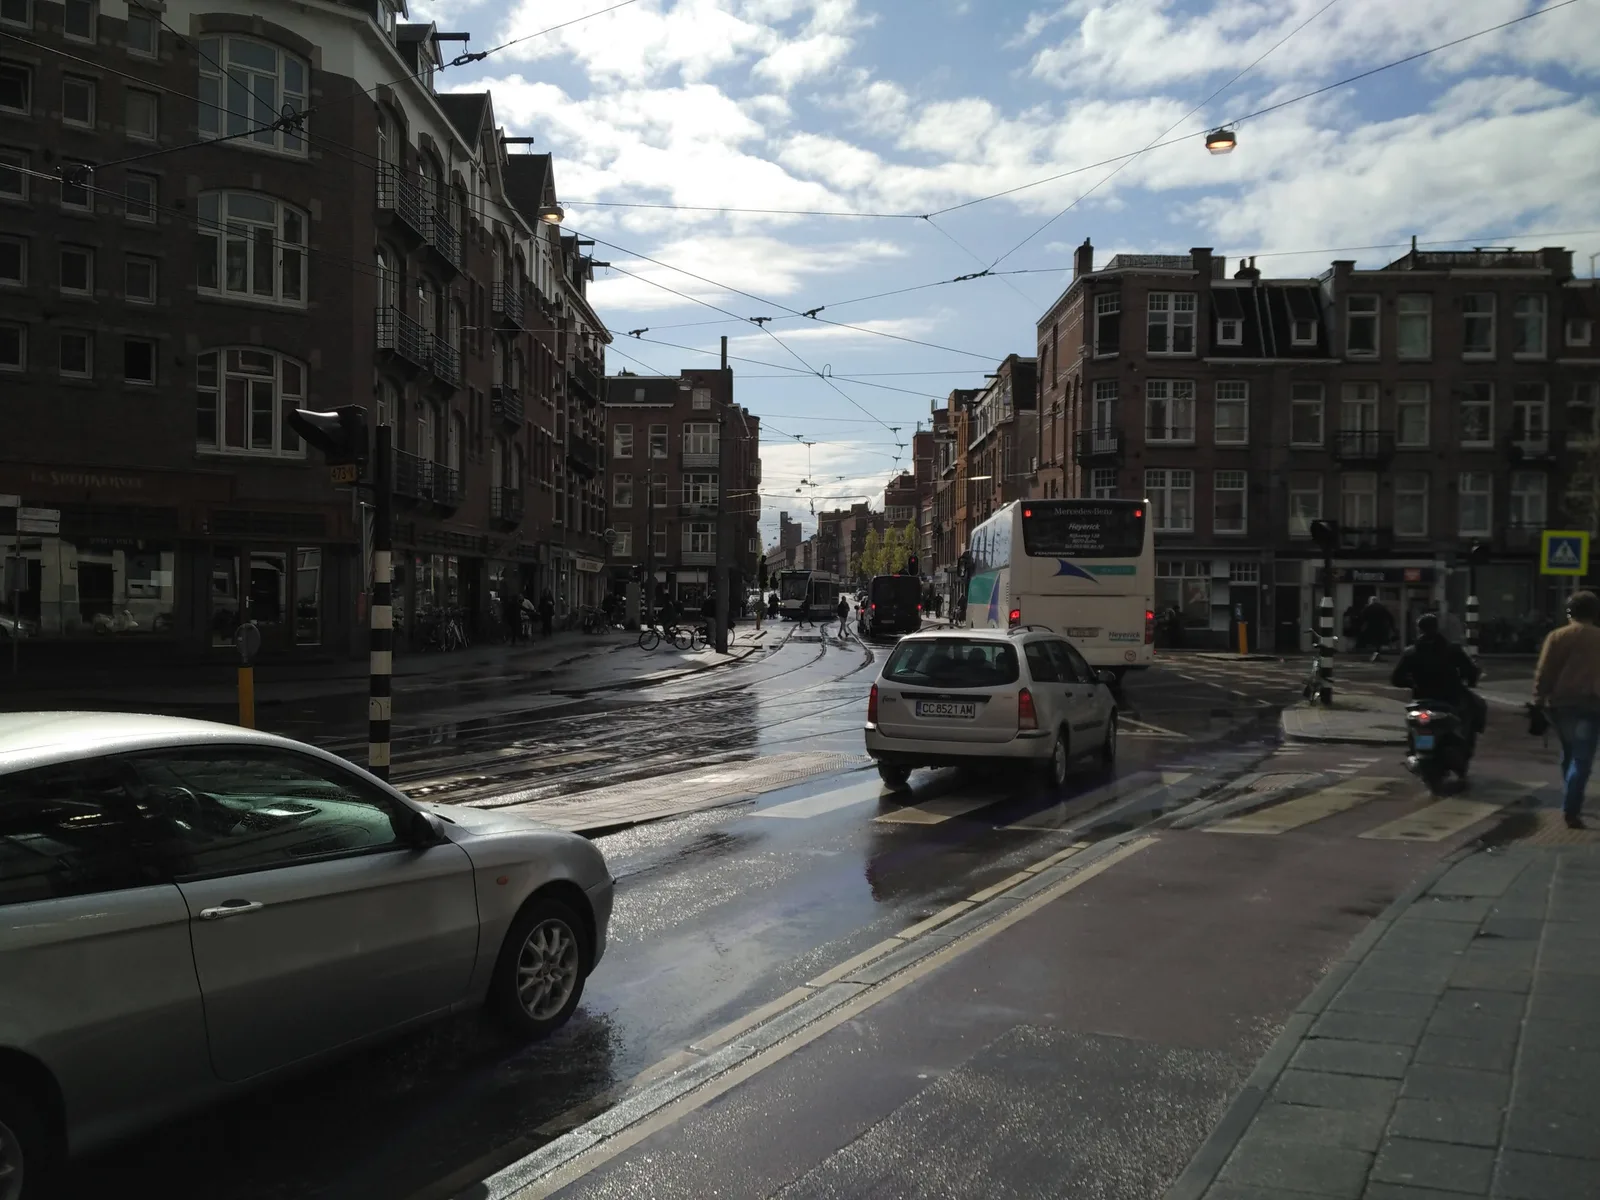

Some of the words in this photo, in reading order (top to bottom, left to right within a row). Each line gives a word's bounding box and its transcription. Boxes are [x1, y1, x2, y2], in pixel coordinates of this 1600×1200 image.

[1054, 507, 1113, 516] Mercedes-Benz
[1068, 522, 1101, 531] Heyerick
[1108, 631, 1141, 640] Heyerick
[922, 703, 935, 713] CC
[936, 703, 958, 714] 8521
[960, 704, 973, 715] AM
